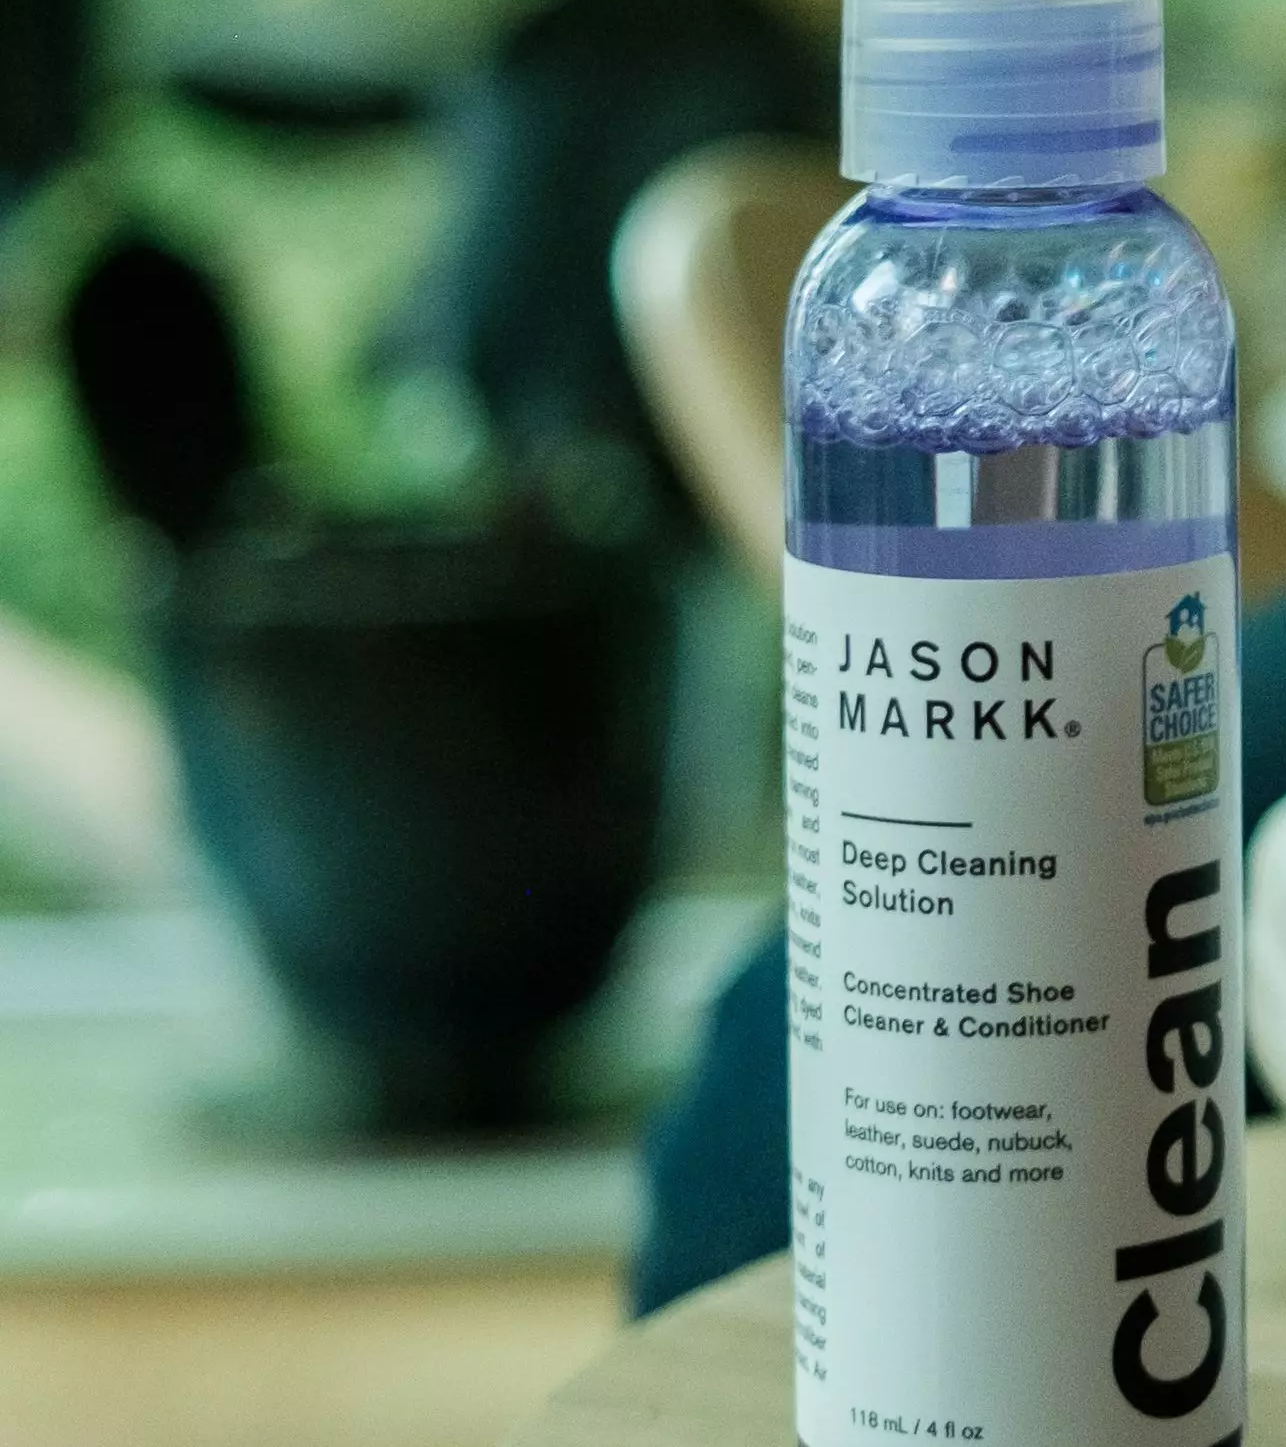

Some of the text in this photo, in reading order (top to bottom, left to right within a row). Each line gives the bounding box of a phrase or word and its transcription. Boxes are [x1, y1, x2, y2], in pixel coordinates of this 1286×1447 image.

[839, 633, 1055, 683] JASON
[1150, 672, 1216, 713] SAFER
[1150, 703, 1217, 743] CHOICE
[842, 839, 1058, 880] Deep Cleaning
[842, 879, 954, 916] Solution
[843, 970, 998, 1004] Concentrated
[1007, 981, 1076, 1004] Shoe
[843, 1004, 1112, 1039] Cleaner & Conditioner
[844, 1086, 1053, 1122] For use on: footwear,
[844, 1117, 1074, 1155] leather, suede, nubuck,
[1112, 859, 1227, 1421] Clean
[845, 1153, 1065, 1184] cotton, knits and more
[850, 1406, 985, 1440] 118 mL / 4 fl oz
